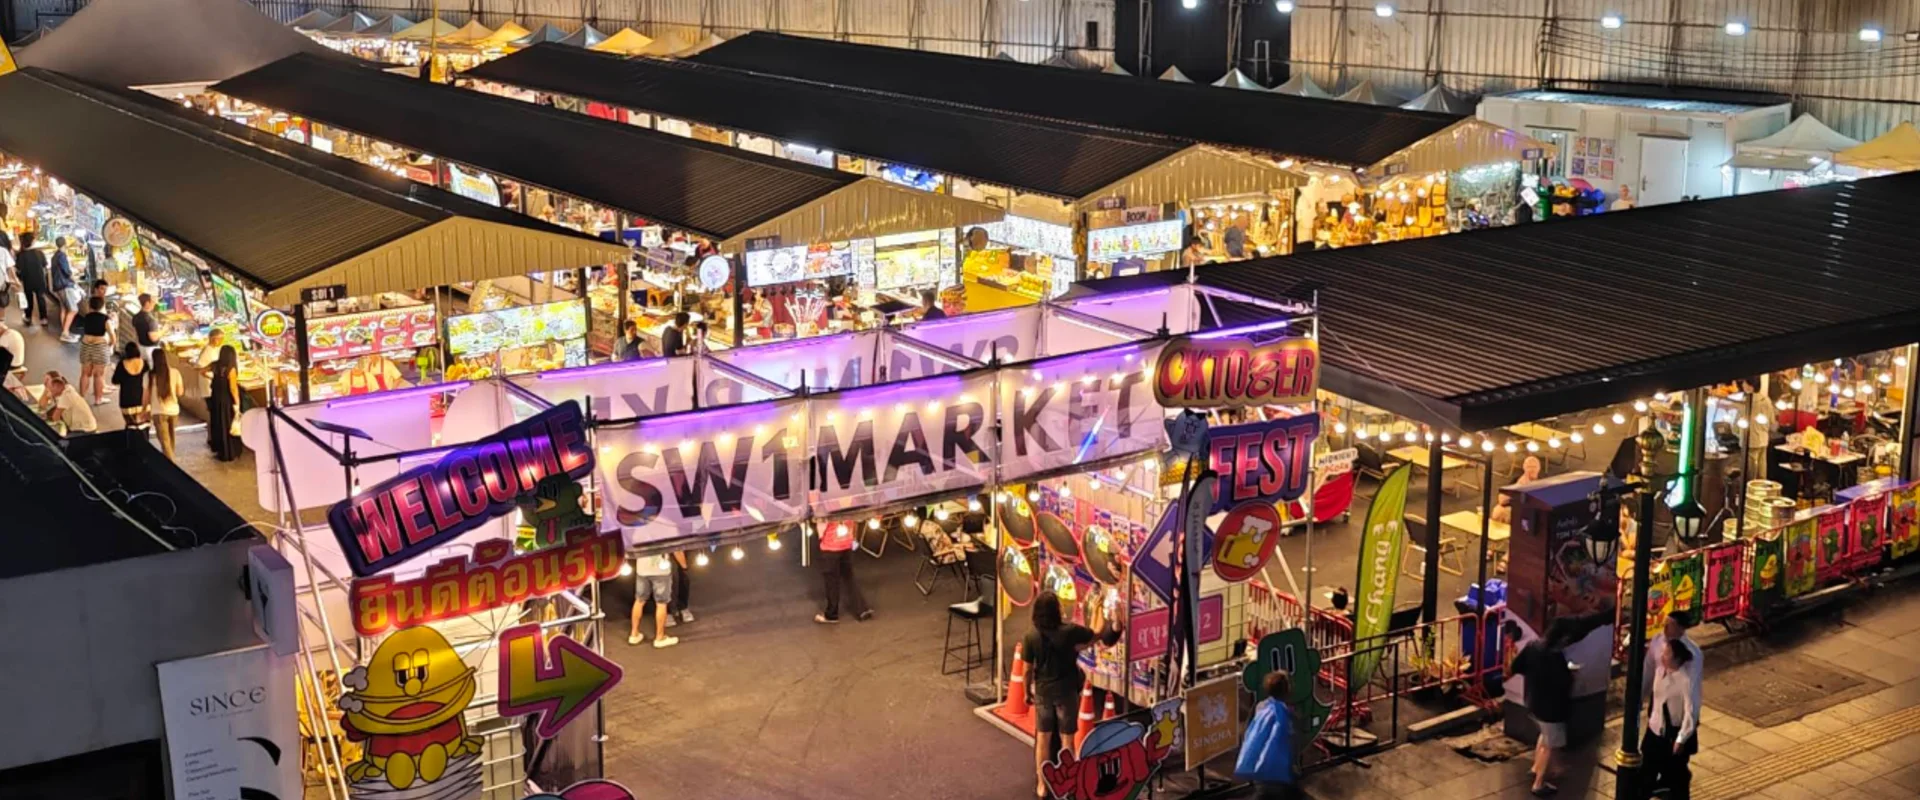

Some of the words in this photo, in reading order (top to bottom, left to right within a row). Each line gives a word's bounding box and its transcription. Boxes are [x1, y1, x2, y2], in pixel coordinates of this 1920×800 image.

[1126, 211, 1147, 223] BOOM
[311, 289, 327, 300] SOI
[330, 288, 335, 298] 1
[1160, 348, 1315, 399] OKTOBER
[345, 412, 589, 564] WELCOME
[1209, 422, 1315, 503] FEST
[358, 534, 620, 631] ยินดีต้อนรับ
[1365, 540, 1391, 625] Chang
[190, 686, 266, 716] SINCE
[1193, 729, 1233, 749] SINGHA
